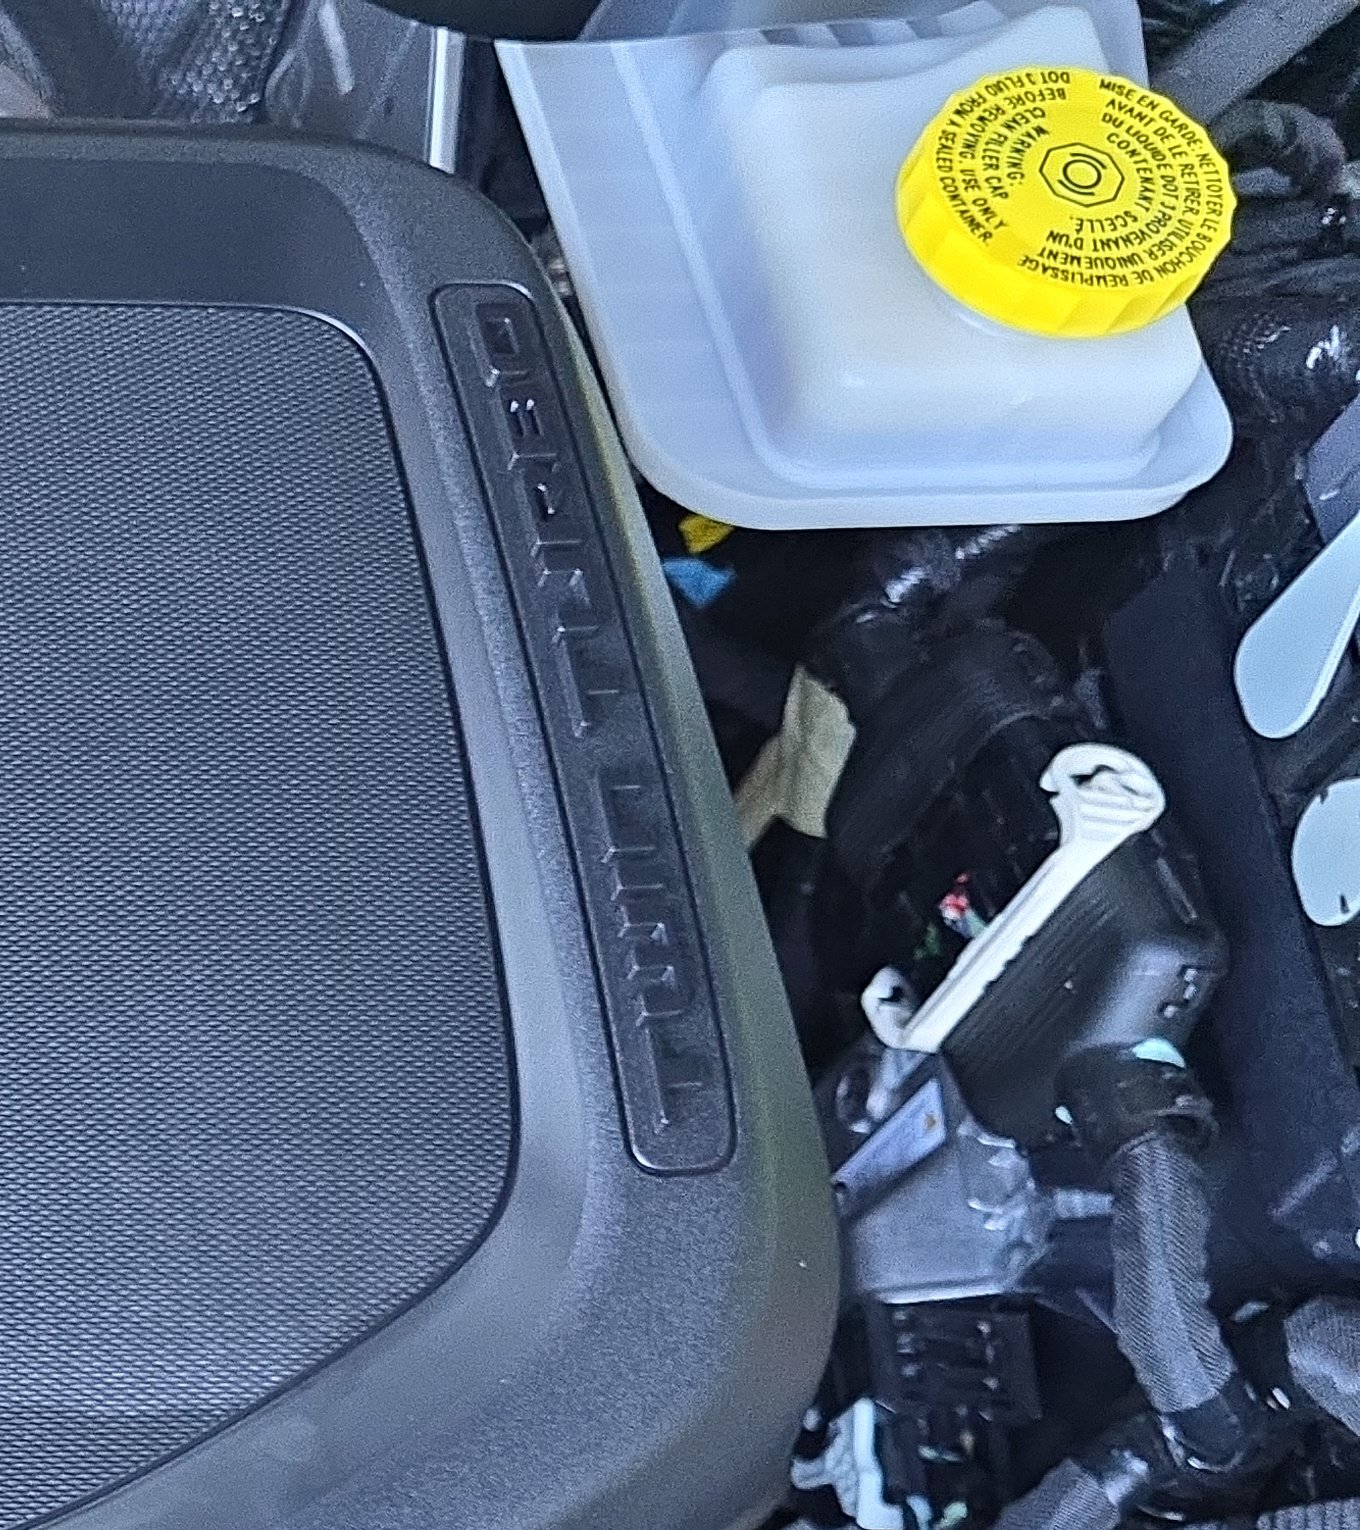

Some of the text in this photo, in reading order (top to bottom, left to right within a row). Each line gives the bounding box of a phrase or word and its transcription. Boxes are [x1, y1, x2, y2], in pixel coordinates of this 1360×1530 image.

[984, 75, 1025, 96] FLUID
[1040, 70, 1071, 84] DOT
[953, 92, 987, 119] FROM
[1101, 112, 1125, 129] DU
[1105, 98, 1157, 128] AVANT
[946, 118, 963, 129] A
[1152, 126, 1177, 144] DE
[936, 130, 957, 172] SEALED
[958, 87, 1067, 231] BEFORE REMOVING. USE ONLY
[981, 106, 1046, 199] CLEAN FILLER CAP
[1005, 125, 1050, 186] WARNING:
[1125, 124, 1174, 171] LIQUIDE
[1167, 144, 1189, 160] LE
[1016, 78, 1224, 288] MISE EN GARDE: NETTOYER LE BOUCHON DE REMPLISSAGE
[1106, 132, 1155, 213] CONTENANT
[1160, 175, 1179, 201] DOT
[1045, 230, 1085, 251] D'UN
[1092, 209, 1173, 252] PROVENANT
[1143, 218, 1195, 261] UTILISER
[1036, 246, 1145, 272] UNIQUEMENT
[467, 300, 622, 740] TURBO
